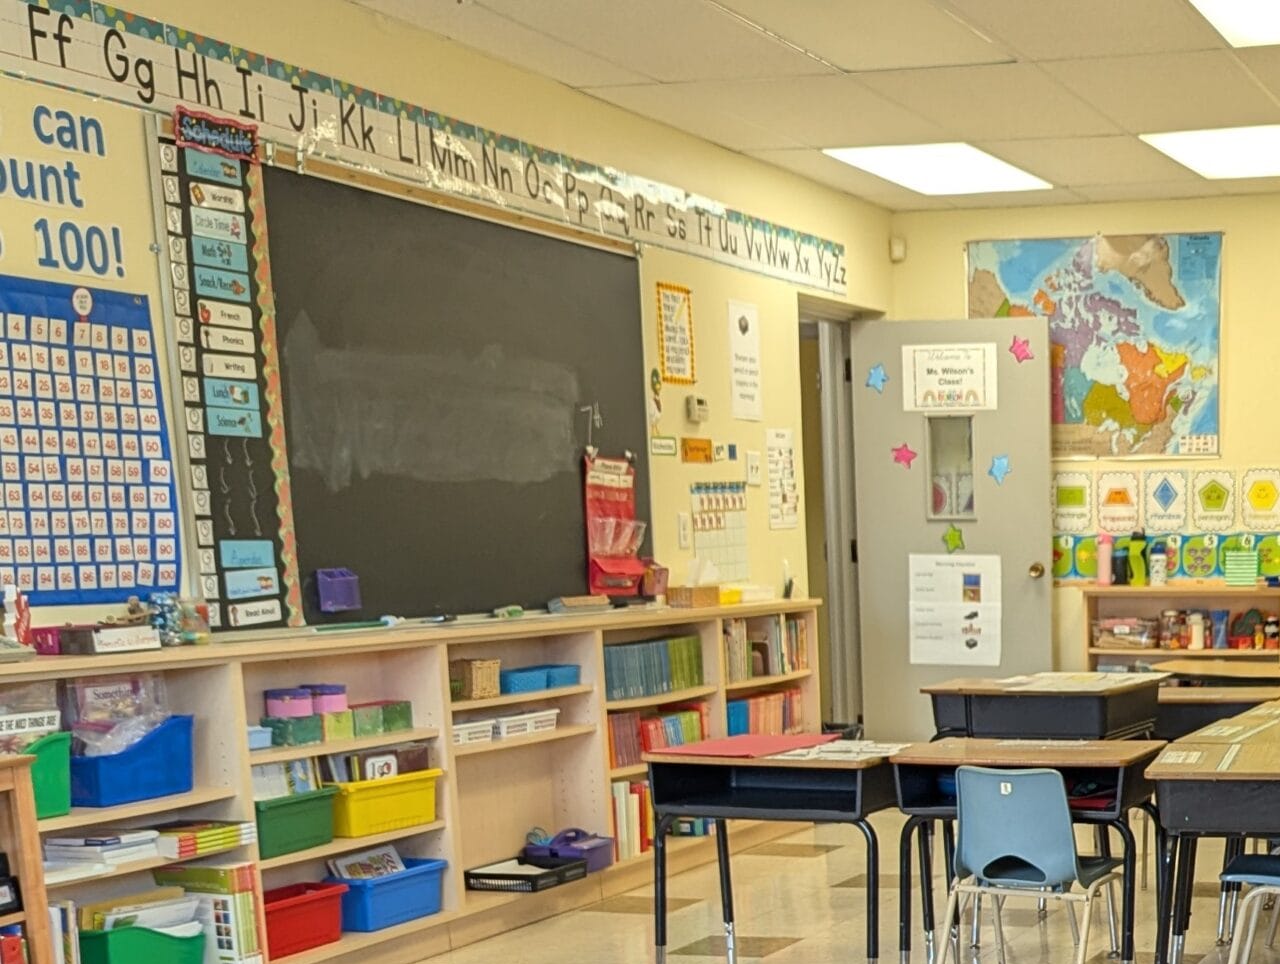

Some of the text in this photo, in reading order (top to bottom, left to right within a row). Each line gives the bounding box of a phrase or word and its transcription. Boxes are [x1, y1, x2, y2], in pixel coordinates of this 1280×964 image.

[33, 105, 106, 157] can
[181, 116, 253, 155] Schedule
[34, 218, 124, 278] 100!
[13, 322, 147, 346] 4 5 6 7 8 9 10
[222, 335, 244, 346] Phonics
[17, 351, 150, 375] 14 15 16 17 18 19 20
[942, 367, 974, 376] Wilson's
[17, 380, 151, 399] 24 25 26 27 28 29 30
[0, 406, 157, 425] 33 34 35 36 37 38 39 40
[3, 434, 16, 446] 43
[93, 686, 133, 701] Somethin
[28, 716, 45, 728] THINGS
